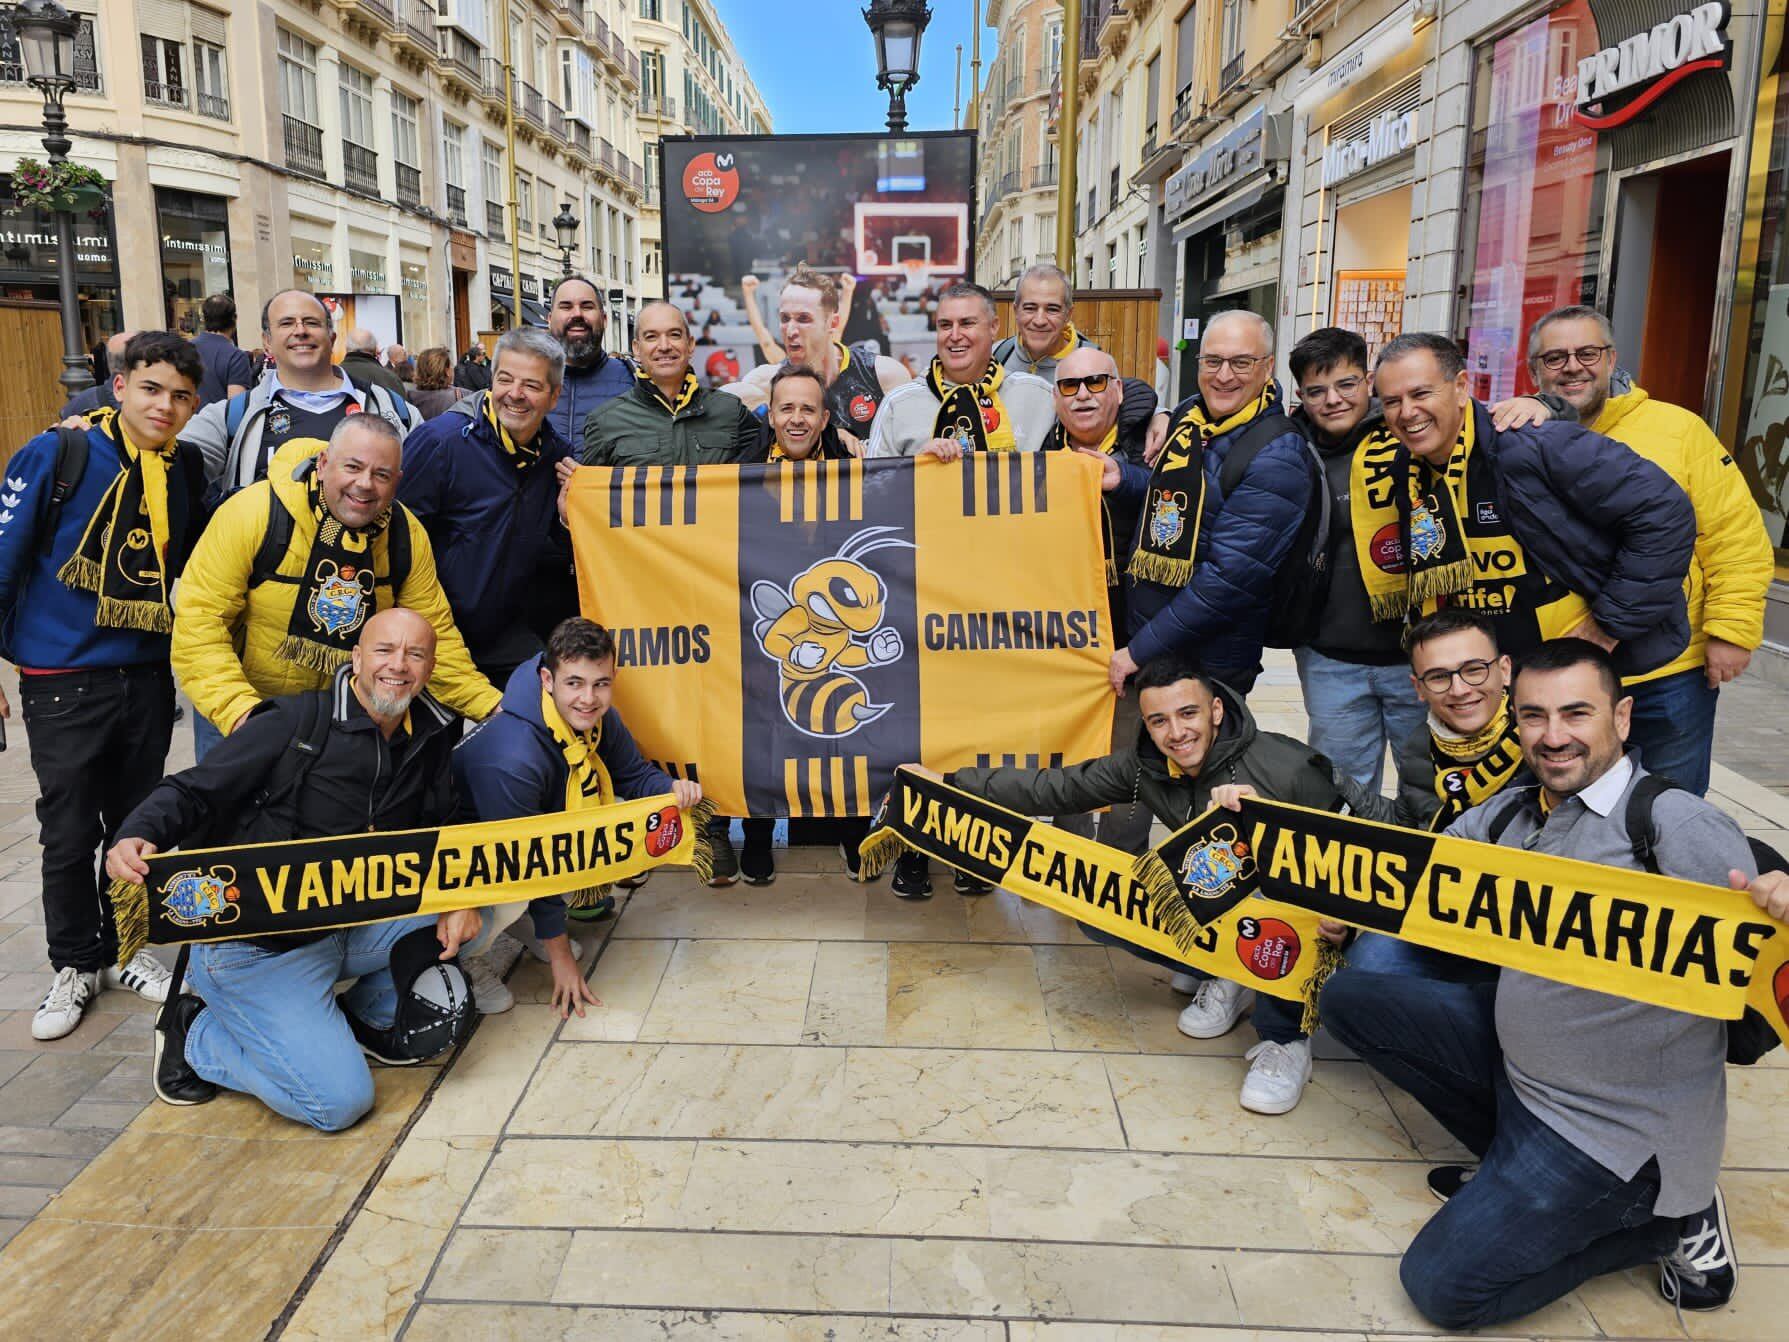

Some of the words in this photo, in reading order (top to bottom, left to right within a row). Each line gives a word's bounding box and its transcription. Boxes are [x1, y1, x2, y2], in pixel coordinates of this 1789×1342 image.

[1576, 2, 1725, 105] PRIMOR
[1552, 73, 1577, 99] Bea
[692, 176, 721, 188] Copa
[706, 187, 726, 198] Rey
[77, 253, 107, 262] uomo
[1471, 550, 1516, 572] VO
[608, 624, 711, 667] AMOS
[924, 611, 1099, 651] CANARIAS!
[902, 785, 1013, 870] VAMOS
[256, 853, 421, 914] VAMOS
[437, 821, 634, 891] CANARIAS
[1428, 863, 1777, 988] CANARIAS
[1258, 939, 1274, 968] Copa
[1271, 937, 1287, 957] Rey
